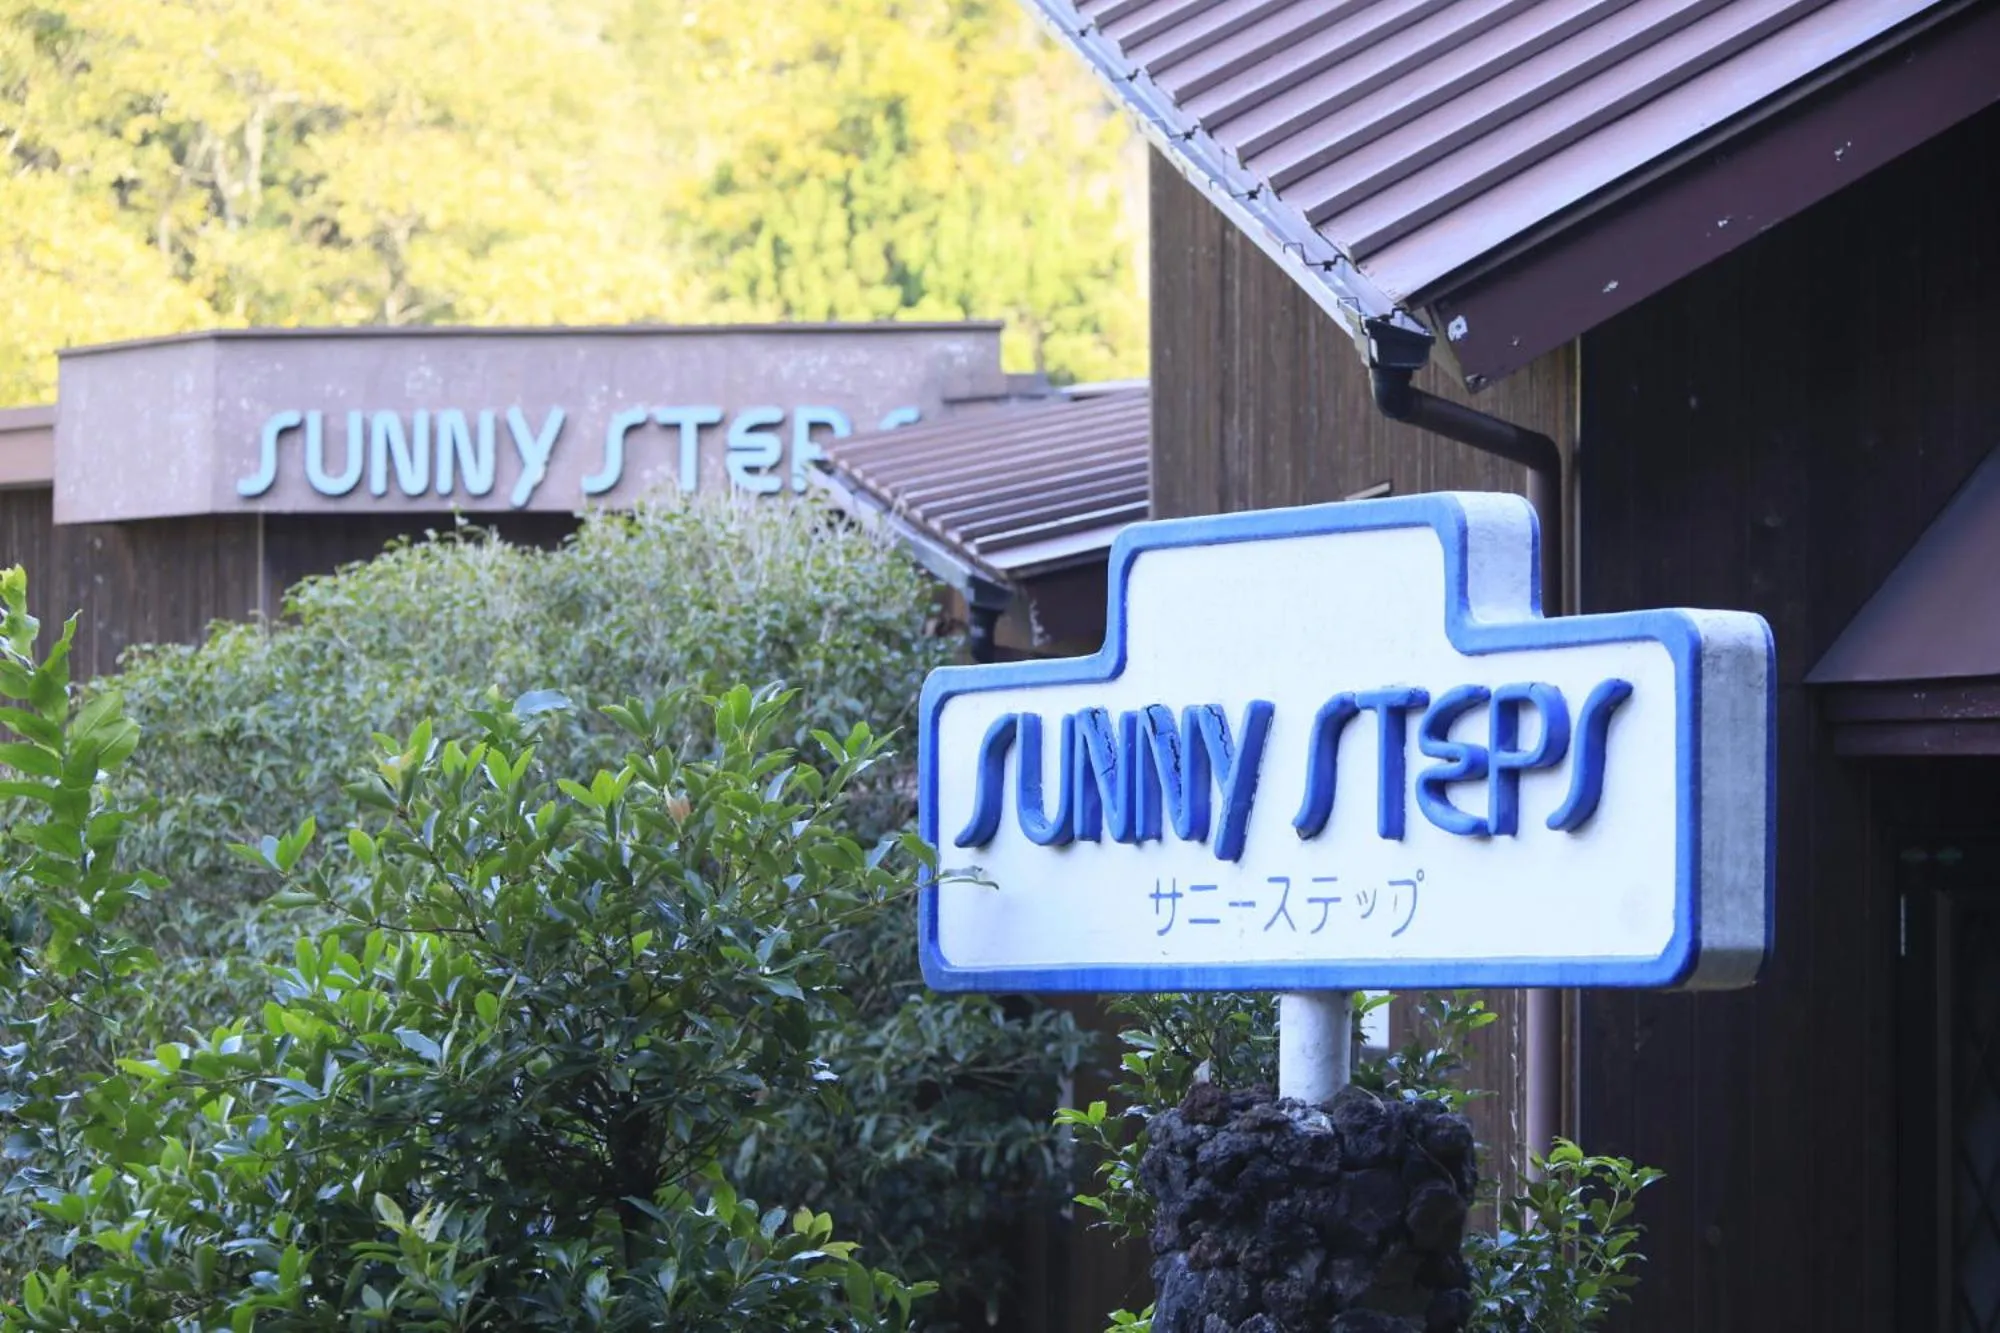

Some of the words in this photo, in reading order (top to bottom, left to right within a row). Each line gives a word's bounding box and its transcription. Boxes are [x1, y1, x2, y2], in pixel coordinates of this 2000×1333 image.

[237, 405, 566, 508] SUNNY
[581, 404, 920, 497] STEP
[954, 699, 1275, 862] SUNNY
[1291, 677, 1634, 841] STEPS
[1149, 868, 1425, 938] サニーステップ
